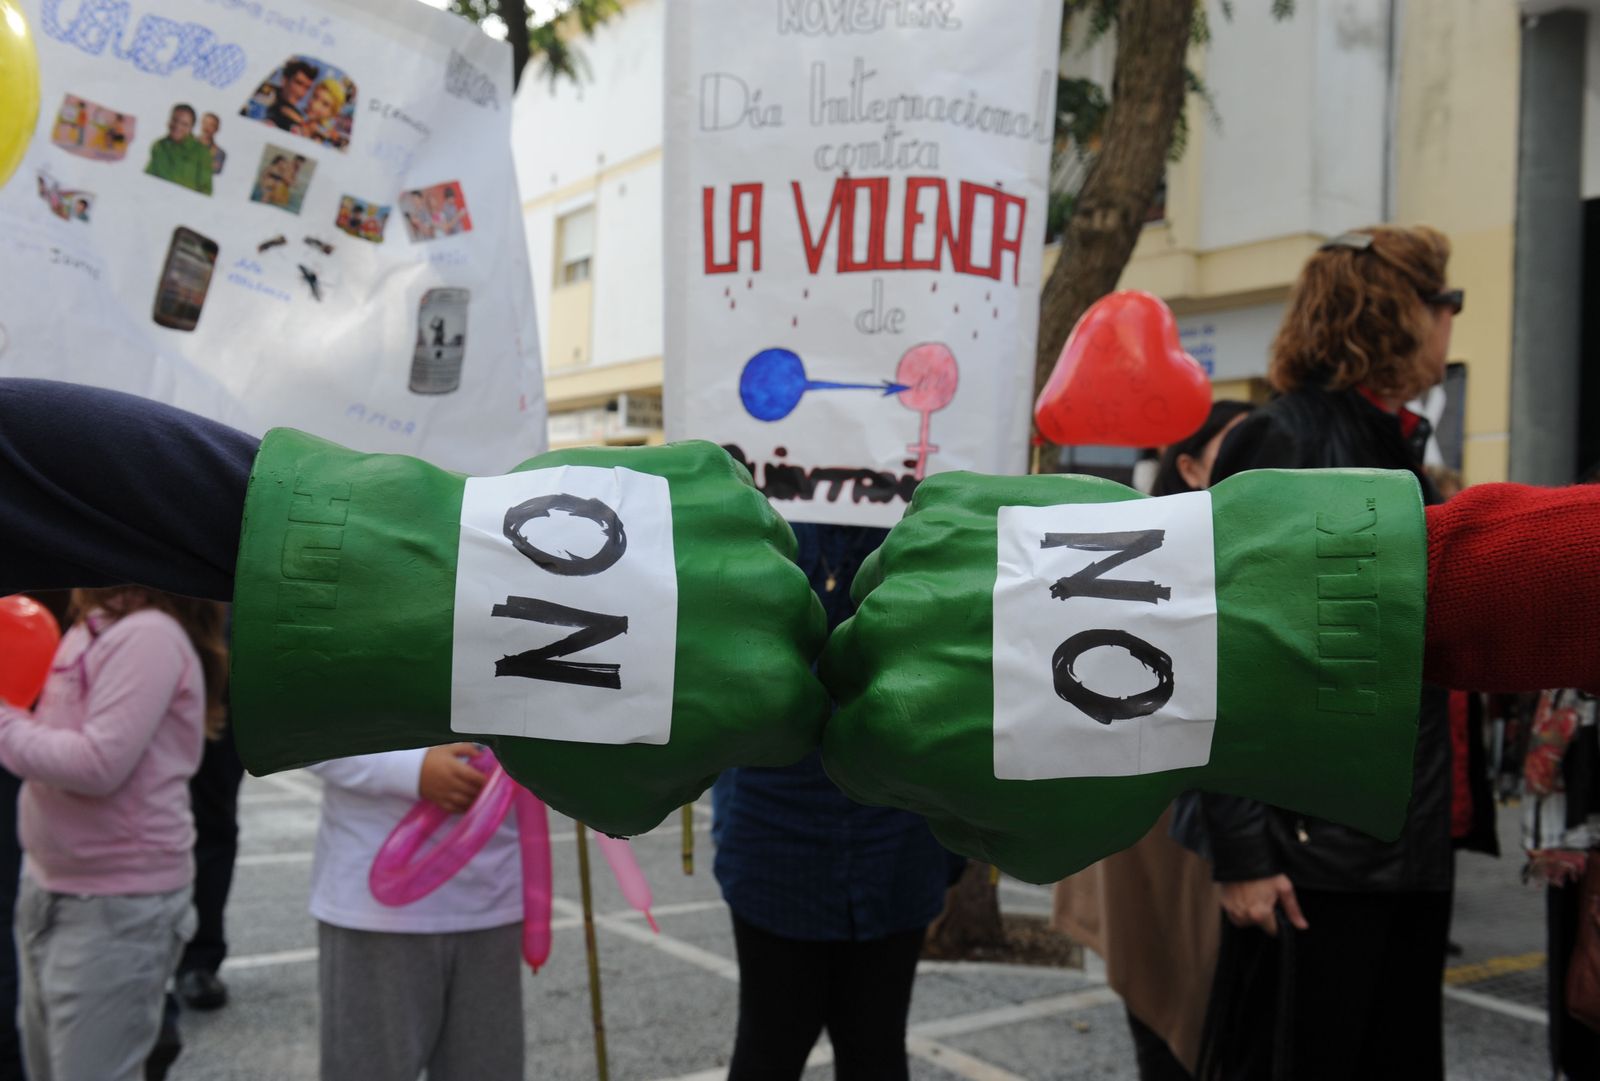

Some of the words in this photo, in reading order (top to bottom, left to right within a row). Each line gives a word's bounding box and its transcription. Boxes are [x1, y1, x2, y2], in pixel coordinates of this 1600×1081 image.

[700, 72, 782, 132] Día
[808, 56, 1052, 145] Internacional
[814, 122, 940, 171] contra
[703, 182, 763, 274] LA
[855, 278, 906, 335] de
[490, 493, 628, 690] NO
[1040, 528, 1175, 726] NO
[1315, 508, 1378, 714] HULK
